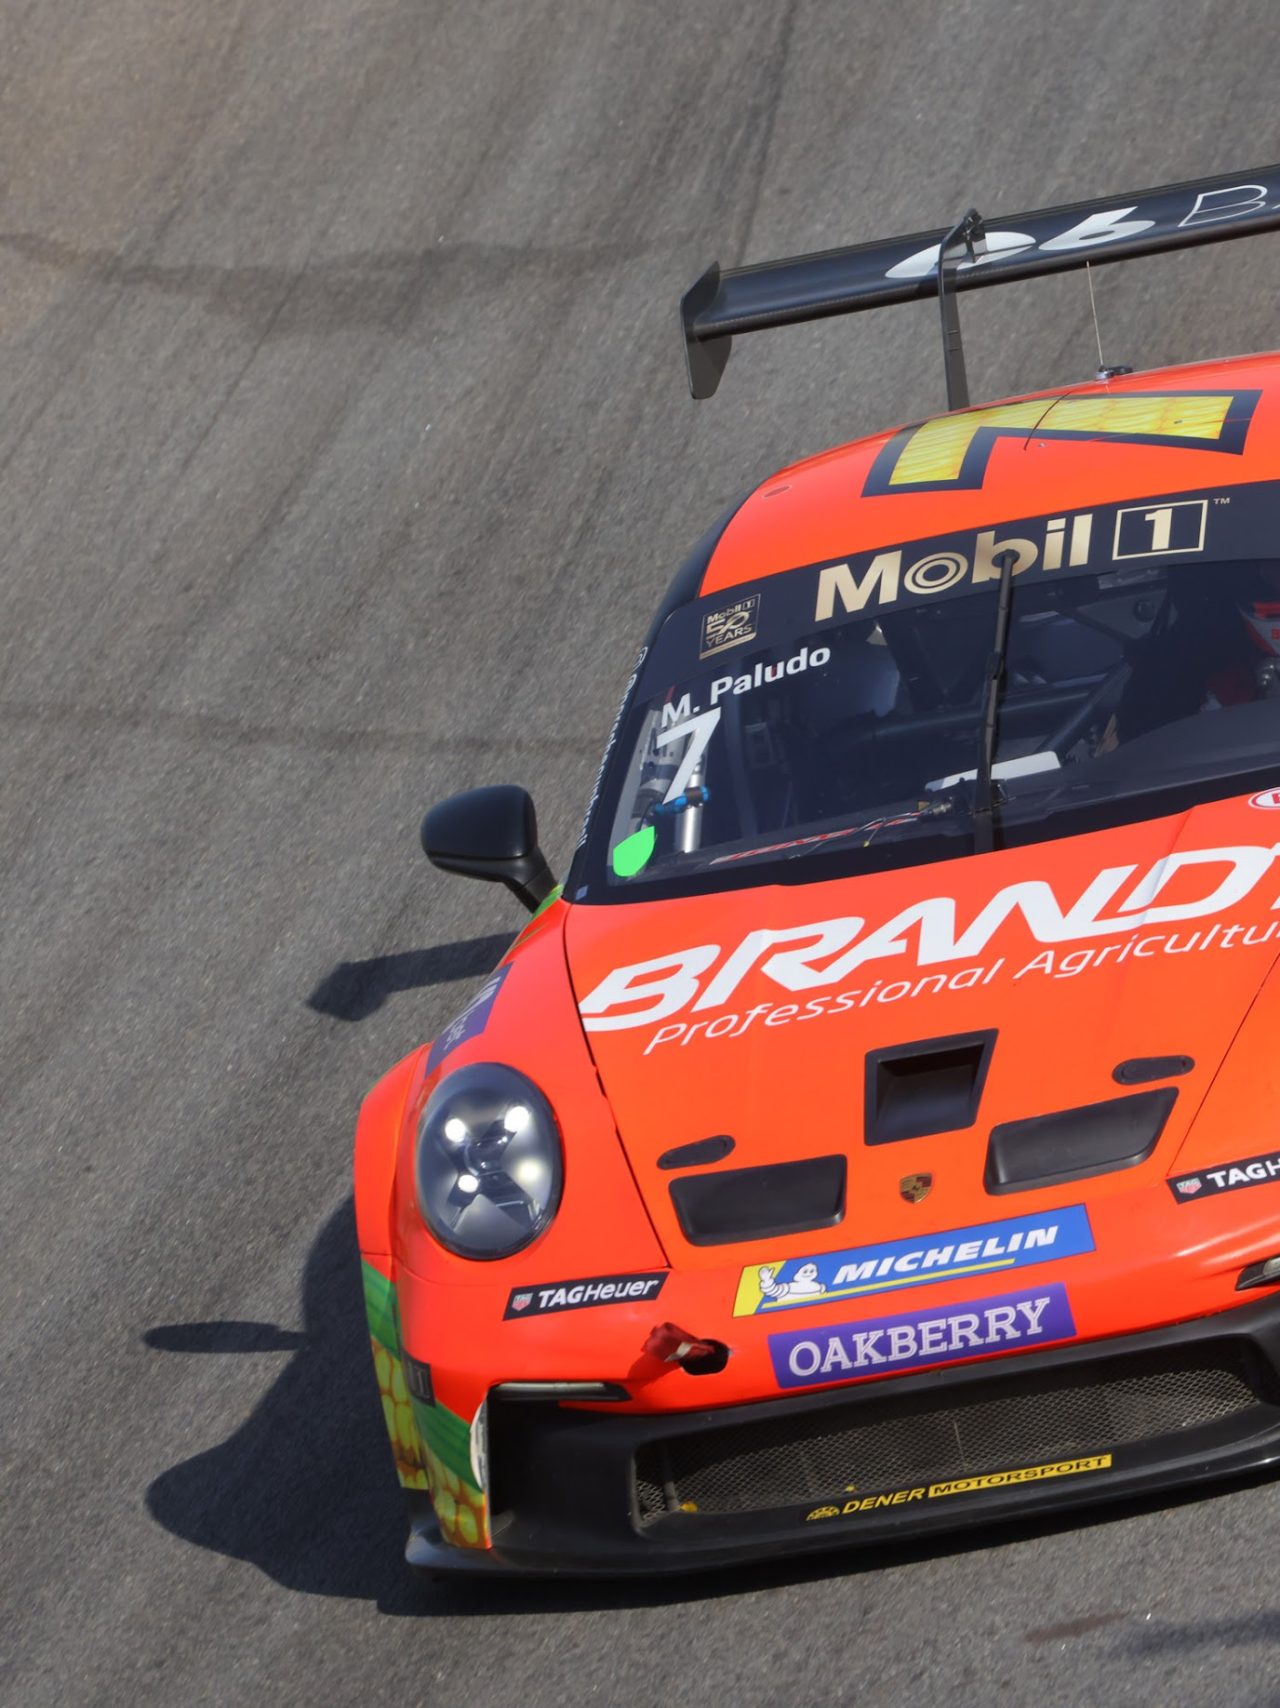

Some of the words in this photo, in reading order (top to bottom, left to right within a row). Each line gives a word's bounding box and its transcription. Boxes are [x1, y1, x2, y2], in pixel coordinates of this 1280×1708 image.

[815, 513, 1093, 622] Mobil
[705, 623, 753, 648] YEARS
[661, 693, 700, 728] M.
[710, 647, 831, 705] Paludo
[656, 707, 721, 805] 7
[643, 957, 1006, 1056] Professional
[832, 1226, 1058, 1285] MICHELIN
[788, 1297, 1050, 1377] OAKBERRY
[842, 1488, 926, 1515] DENER
[933, 1456, 1108, 1495] MOTORSPORT
